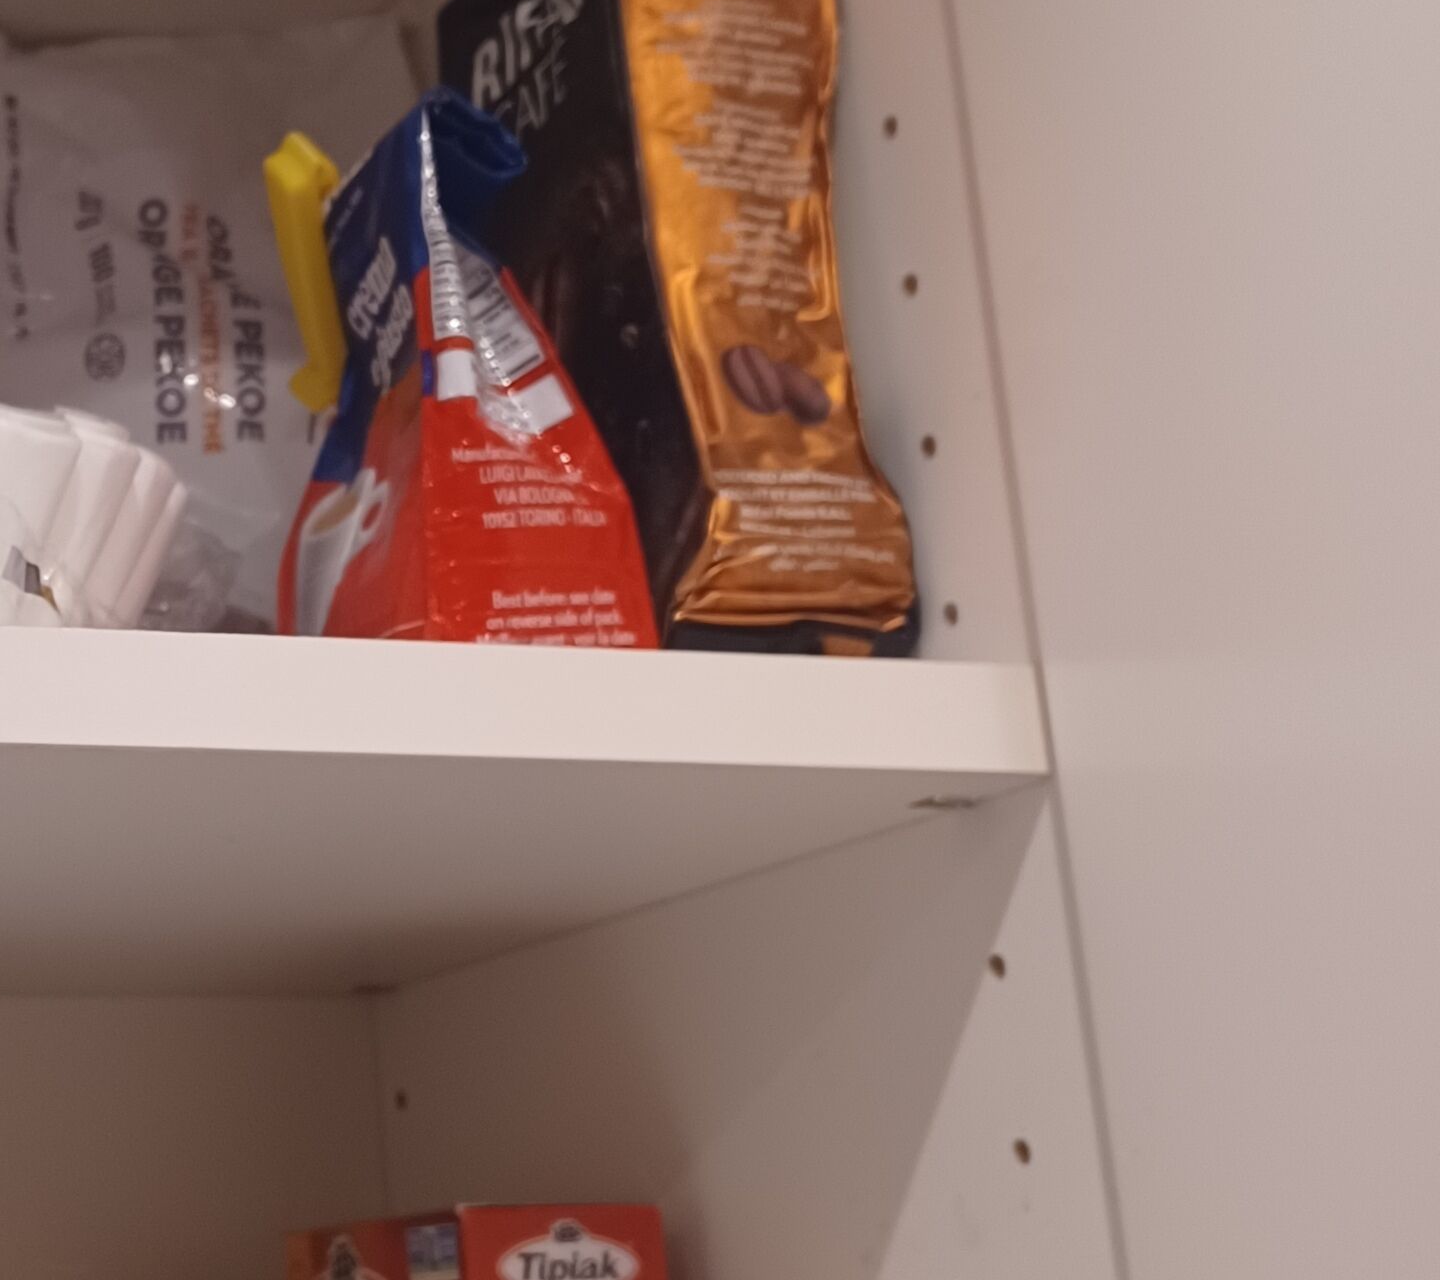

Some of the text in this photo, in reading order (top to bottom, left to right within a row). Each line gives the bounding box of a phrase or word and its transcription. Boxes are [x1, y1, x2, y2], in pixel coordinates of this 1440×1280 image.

[154, 314, 187, 444] PEKOE
[234, 319, 265, 442] PEKOE
[492, 590, 521, 609] Best
